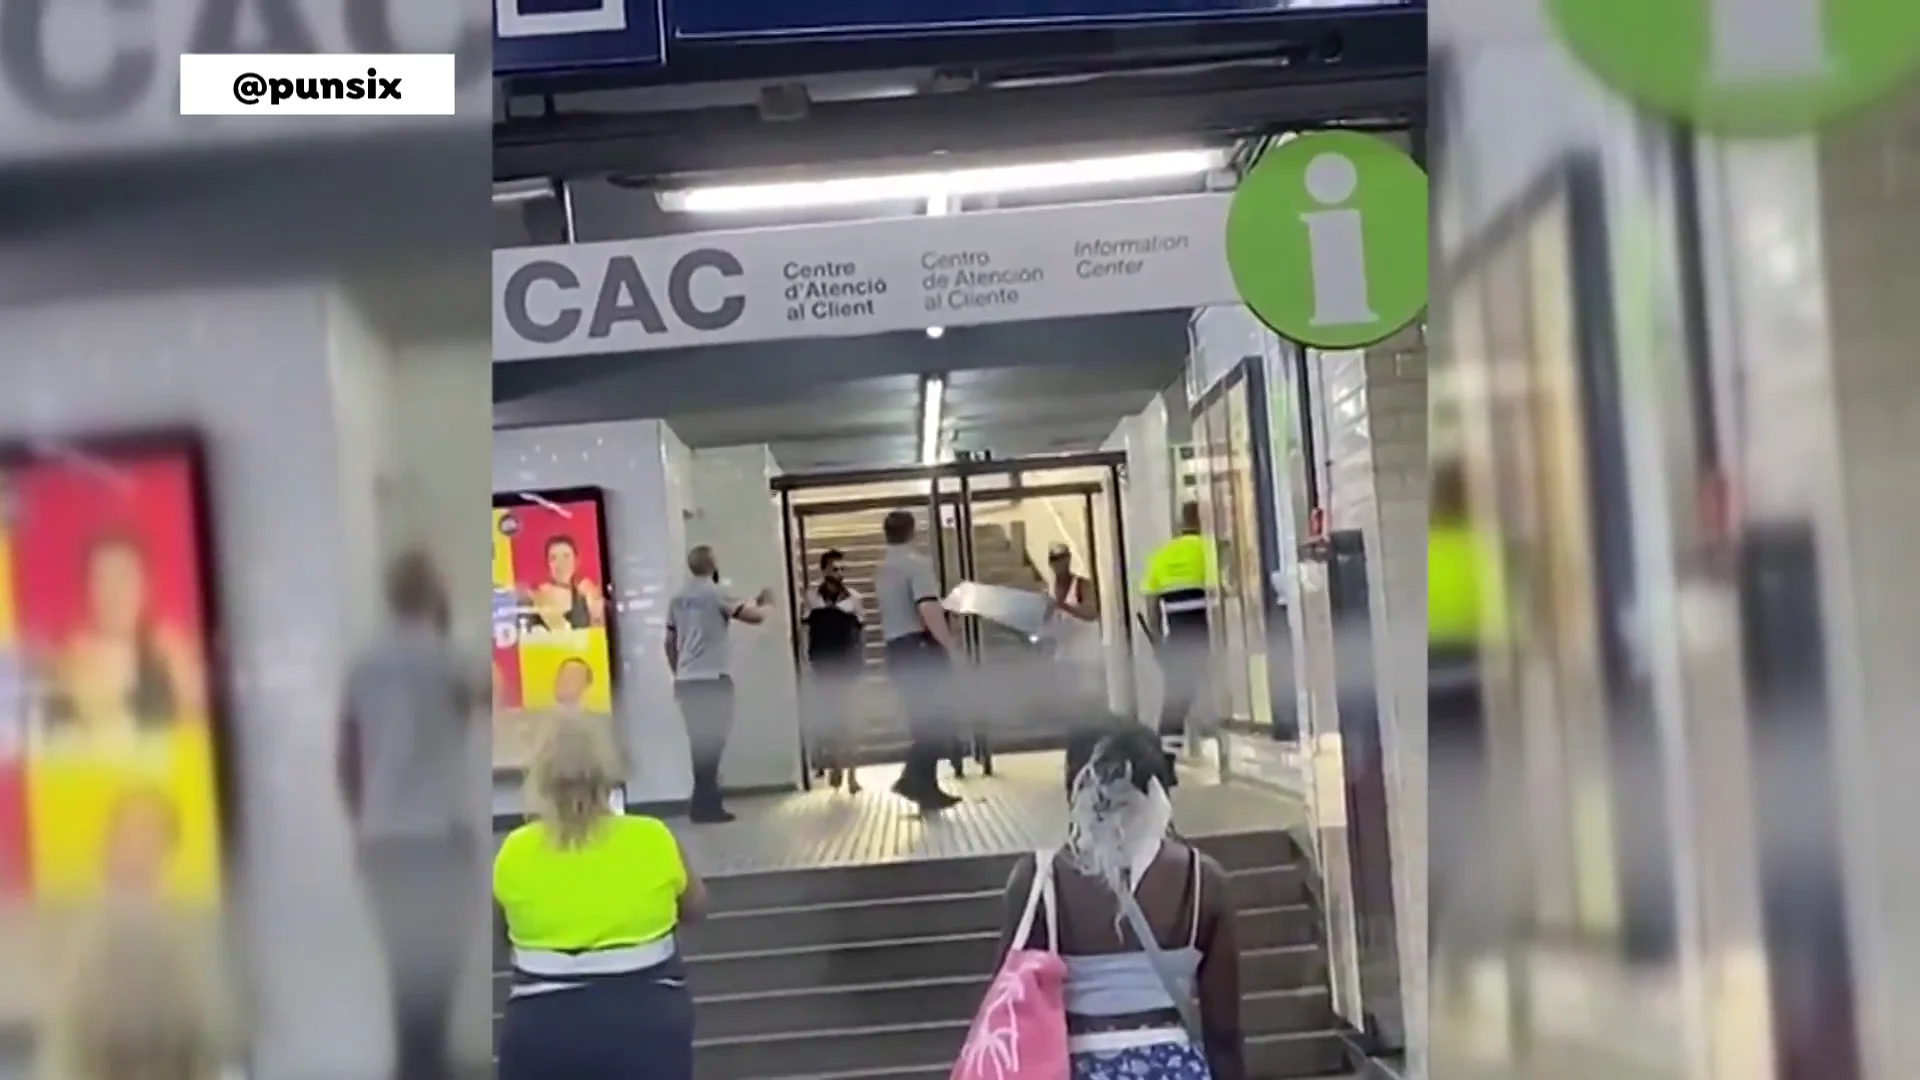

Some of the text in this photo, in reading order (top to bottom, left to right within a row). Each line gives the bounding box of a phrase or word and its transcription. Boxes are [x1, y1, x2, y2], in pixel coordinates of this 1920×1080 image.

[783, 261, 856, 280] Centre
[921, 251, 991, 270] Centro
[1076, 259, 1144, 280] Center
[922, 272, 949, 291] de
[504, 248, 746, 344] CAC
[924, 287, 1019, 311] al Cliente
[787, 299, 876, 321] al Client
